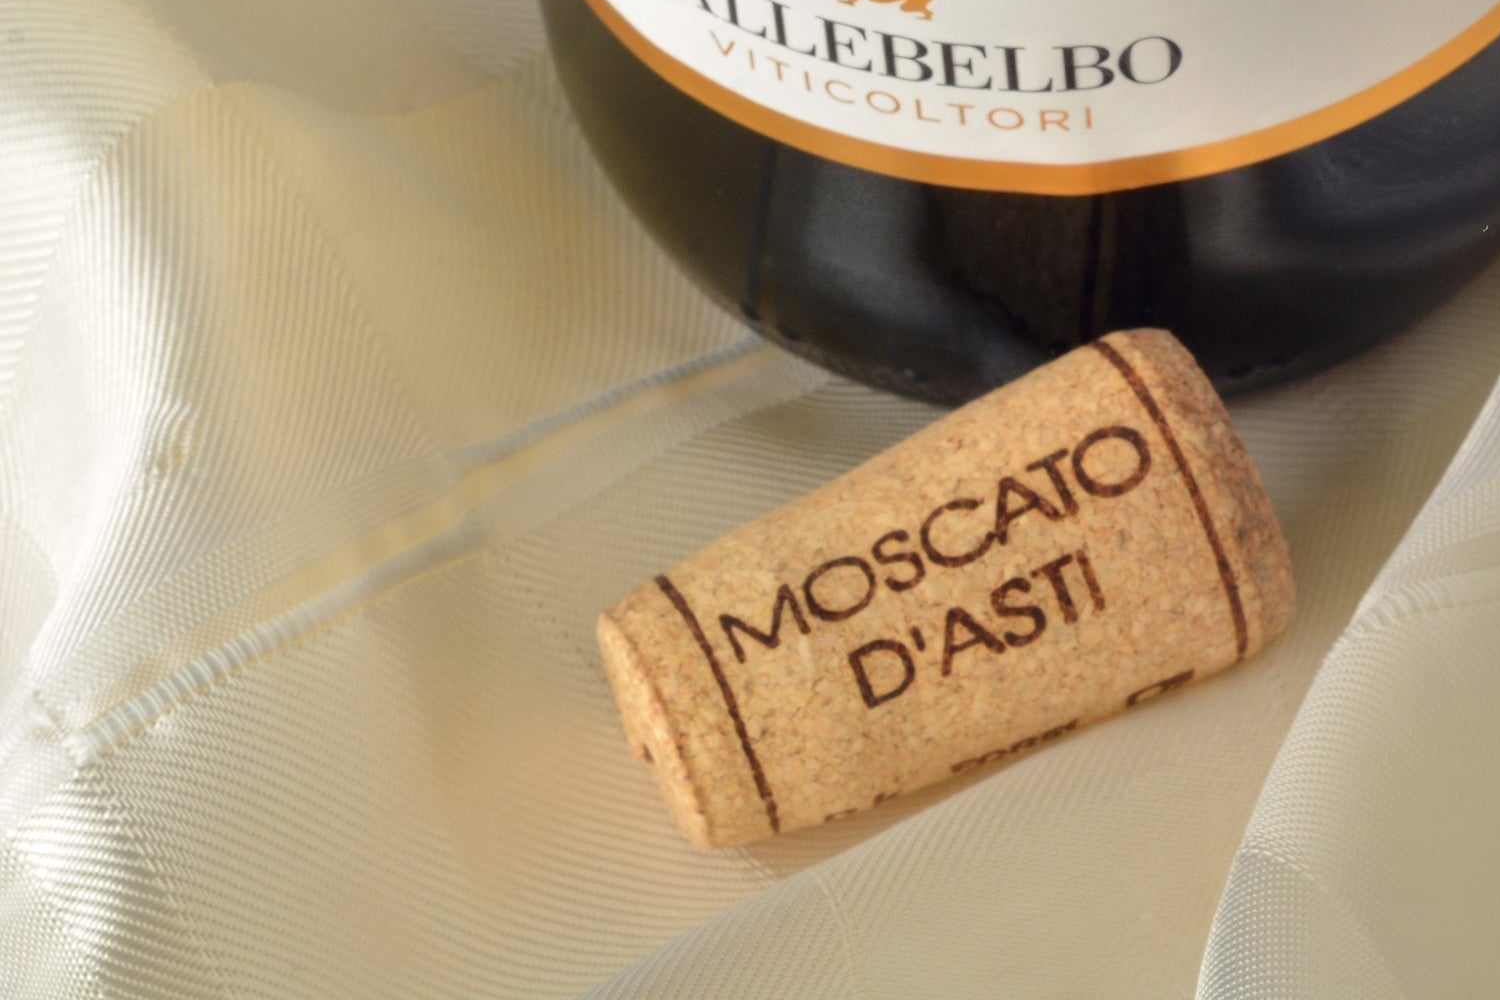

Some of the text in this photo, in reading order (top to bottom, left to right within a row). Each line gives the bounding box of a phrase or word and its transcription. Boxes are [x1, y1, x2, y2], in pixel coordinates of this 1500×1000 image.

[709, 30, 1094, 132] VITICOLTORI
[719, 426, 1151, 663] MOSCATO
[848, 550, 1105, 708] D'ASTI
